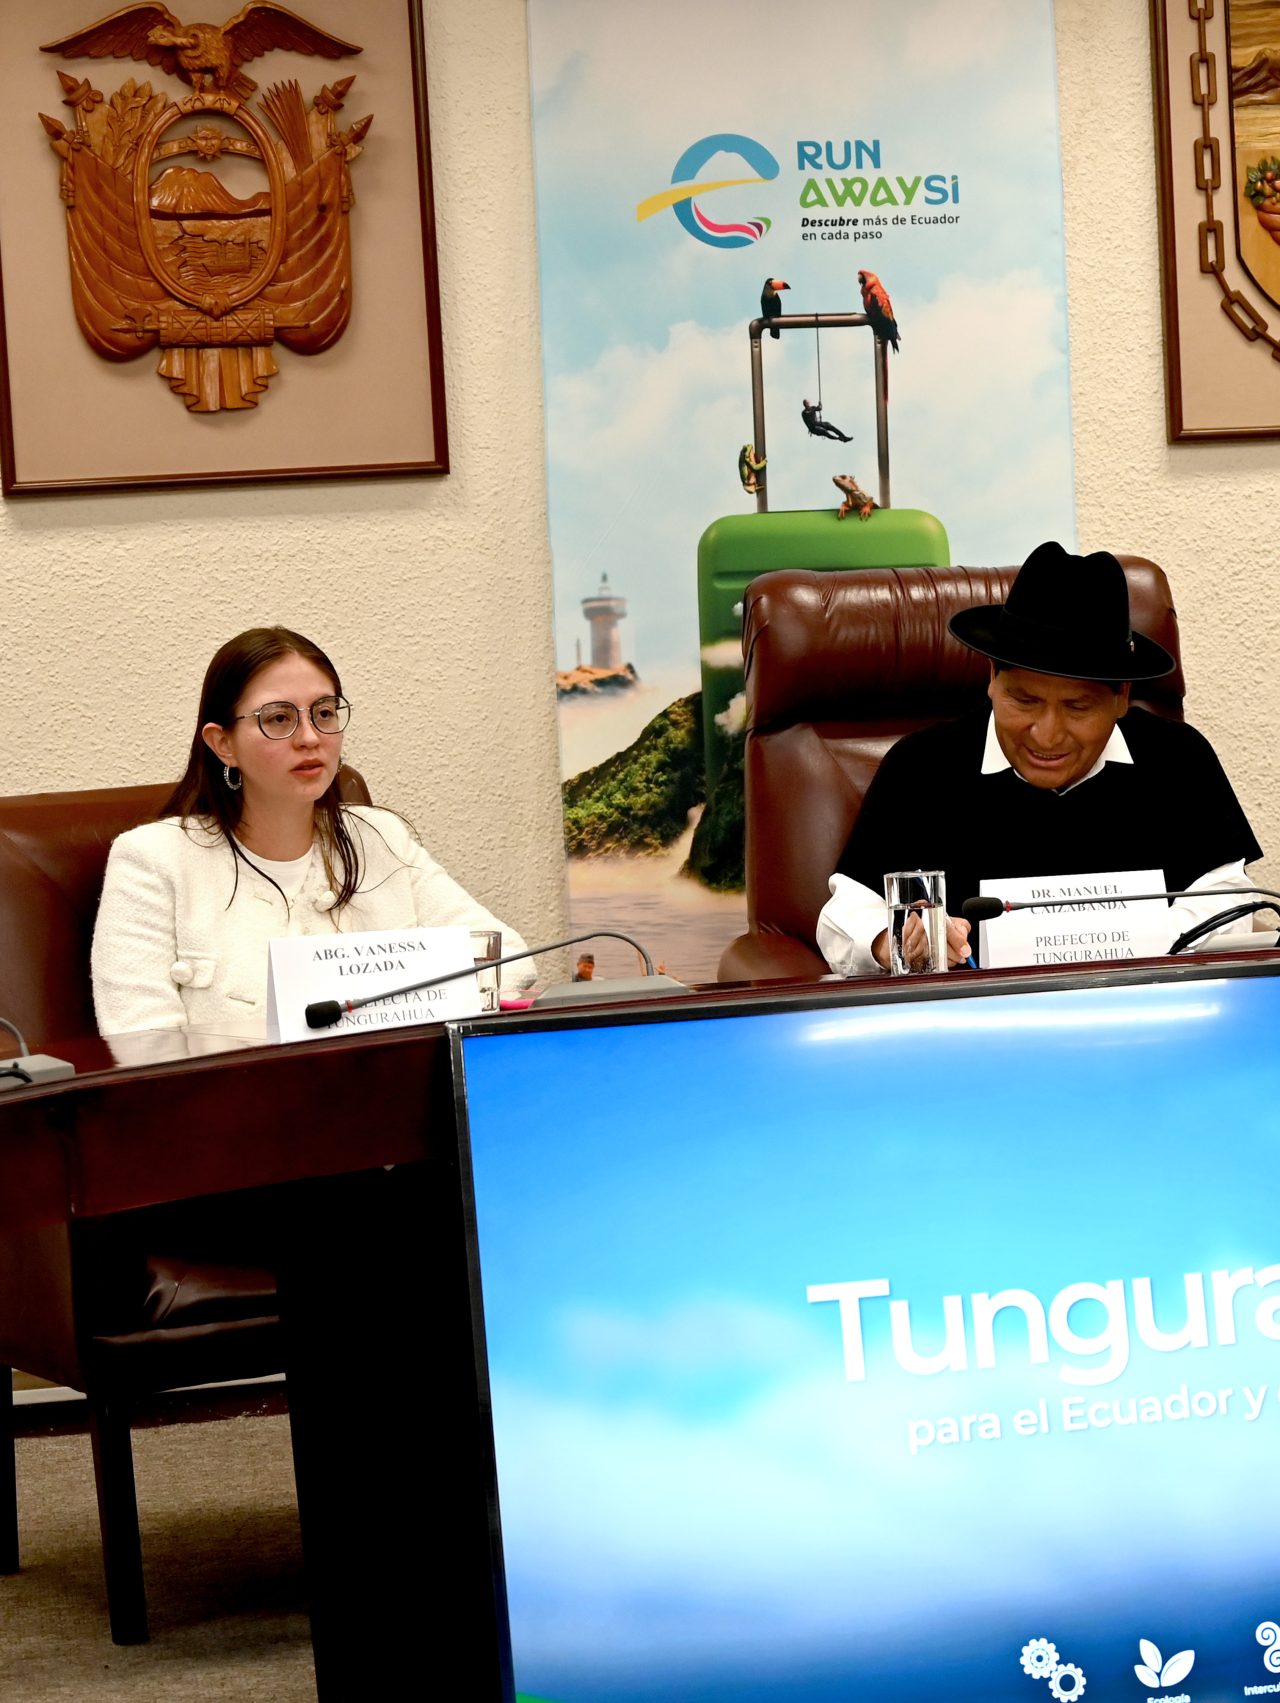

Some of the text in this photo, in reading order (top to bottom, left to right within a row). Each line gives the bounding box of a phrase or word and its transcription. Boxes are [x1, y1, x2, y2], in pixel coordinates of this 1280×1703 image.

[797, 140, 881, 170] RUN
[801, 213, 960, 227] Descubre más de Ecuador
[801, 230, 883, 242] en cada paso
[1031, 884, 1123, 899] DR. MANUEL
[1035, 930, 1131, 948] PREFECTO DE
[312, 940, 427, 962] ABG. VANESSA
[1032, 947, 1135, 964] TUNGURAHUA
[338, 959, 406, 976] LOZADA
[427, 988, 448, 1001] DE
[907, 1410, 1002, 1455] para
[1013, 1397, 1050, 1436] el
[1061, 1382, 1233, 1432] Ecuador
[1242, 1385, 1268, 1421] y
